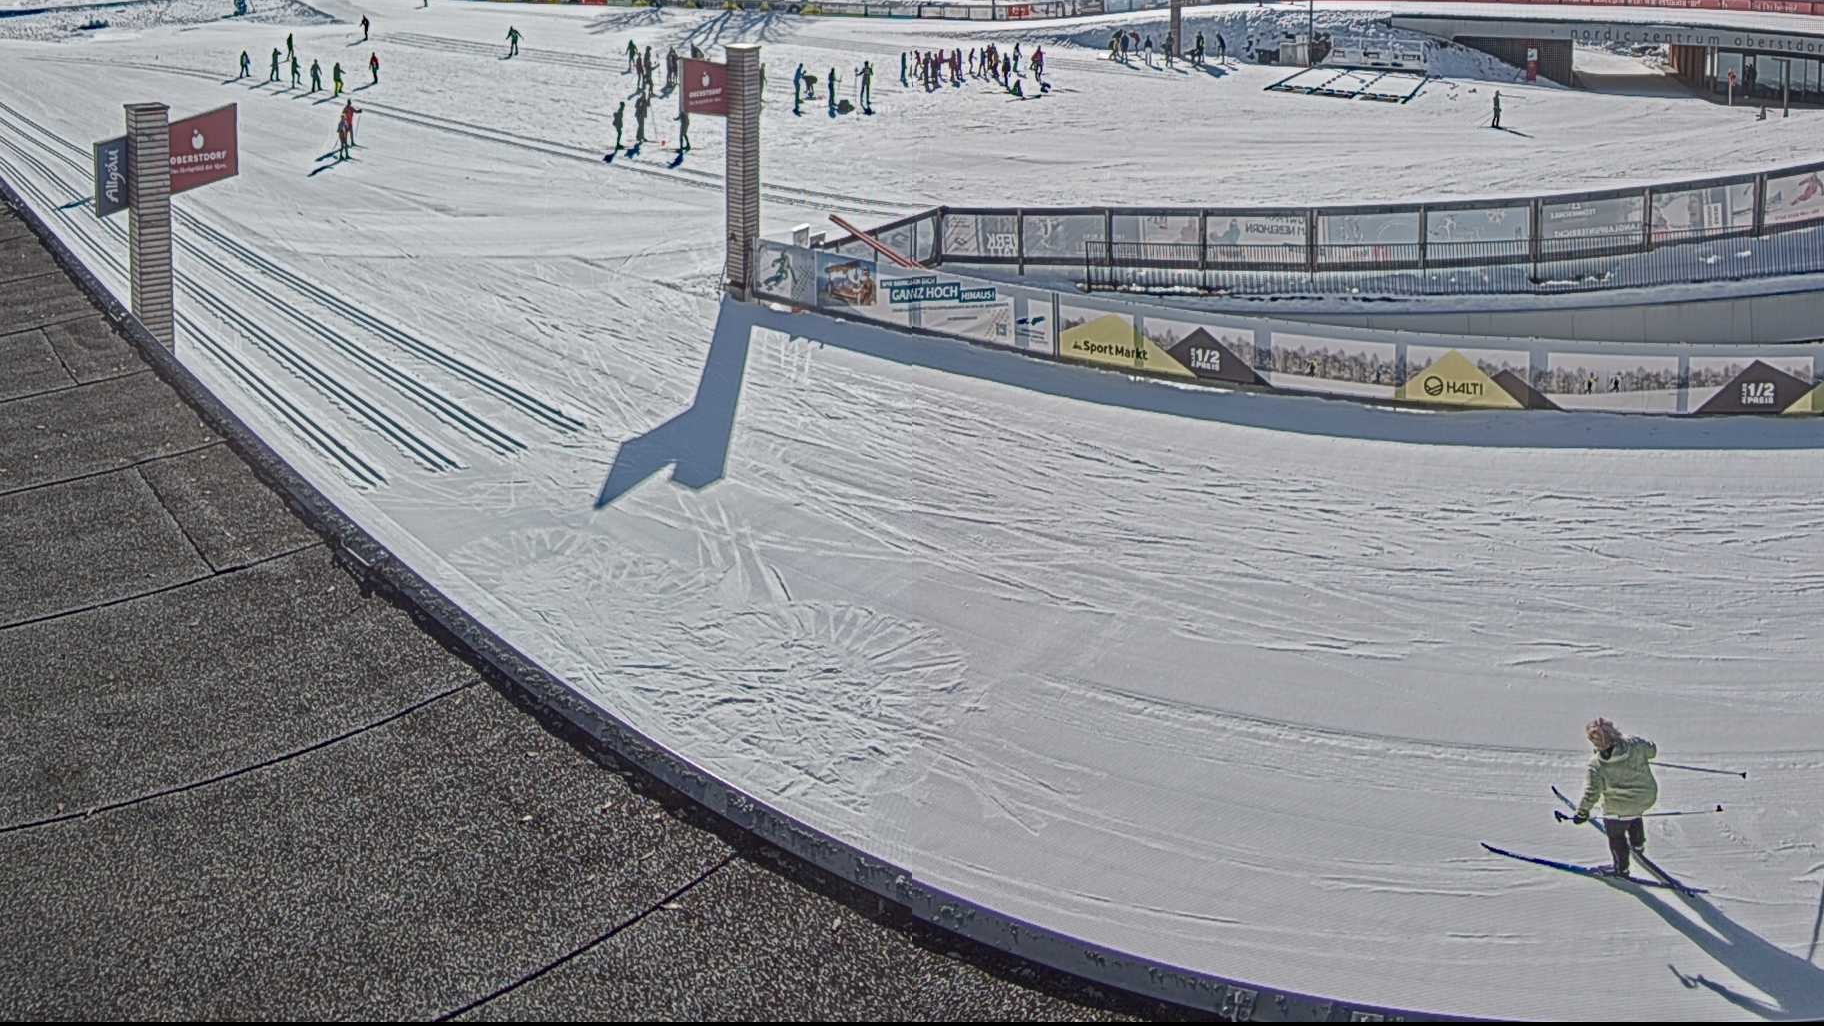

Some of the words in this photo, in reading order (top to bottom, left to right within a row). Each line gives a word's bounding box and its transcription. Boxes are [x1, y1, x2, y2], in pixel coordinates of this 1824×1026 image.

[169, 150, 228, 165] OBERSTDORF
[104, 147, 127, 205] Allgäu
[925, 285, 958, 299] HOCH
[1195, 347, 1220, 363] 1/2
[1446, 381, 1484, 396] HALTI
[1748, 382, 1775, 397] 1/2
